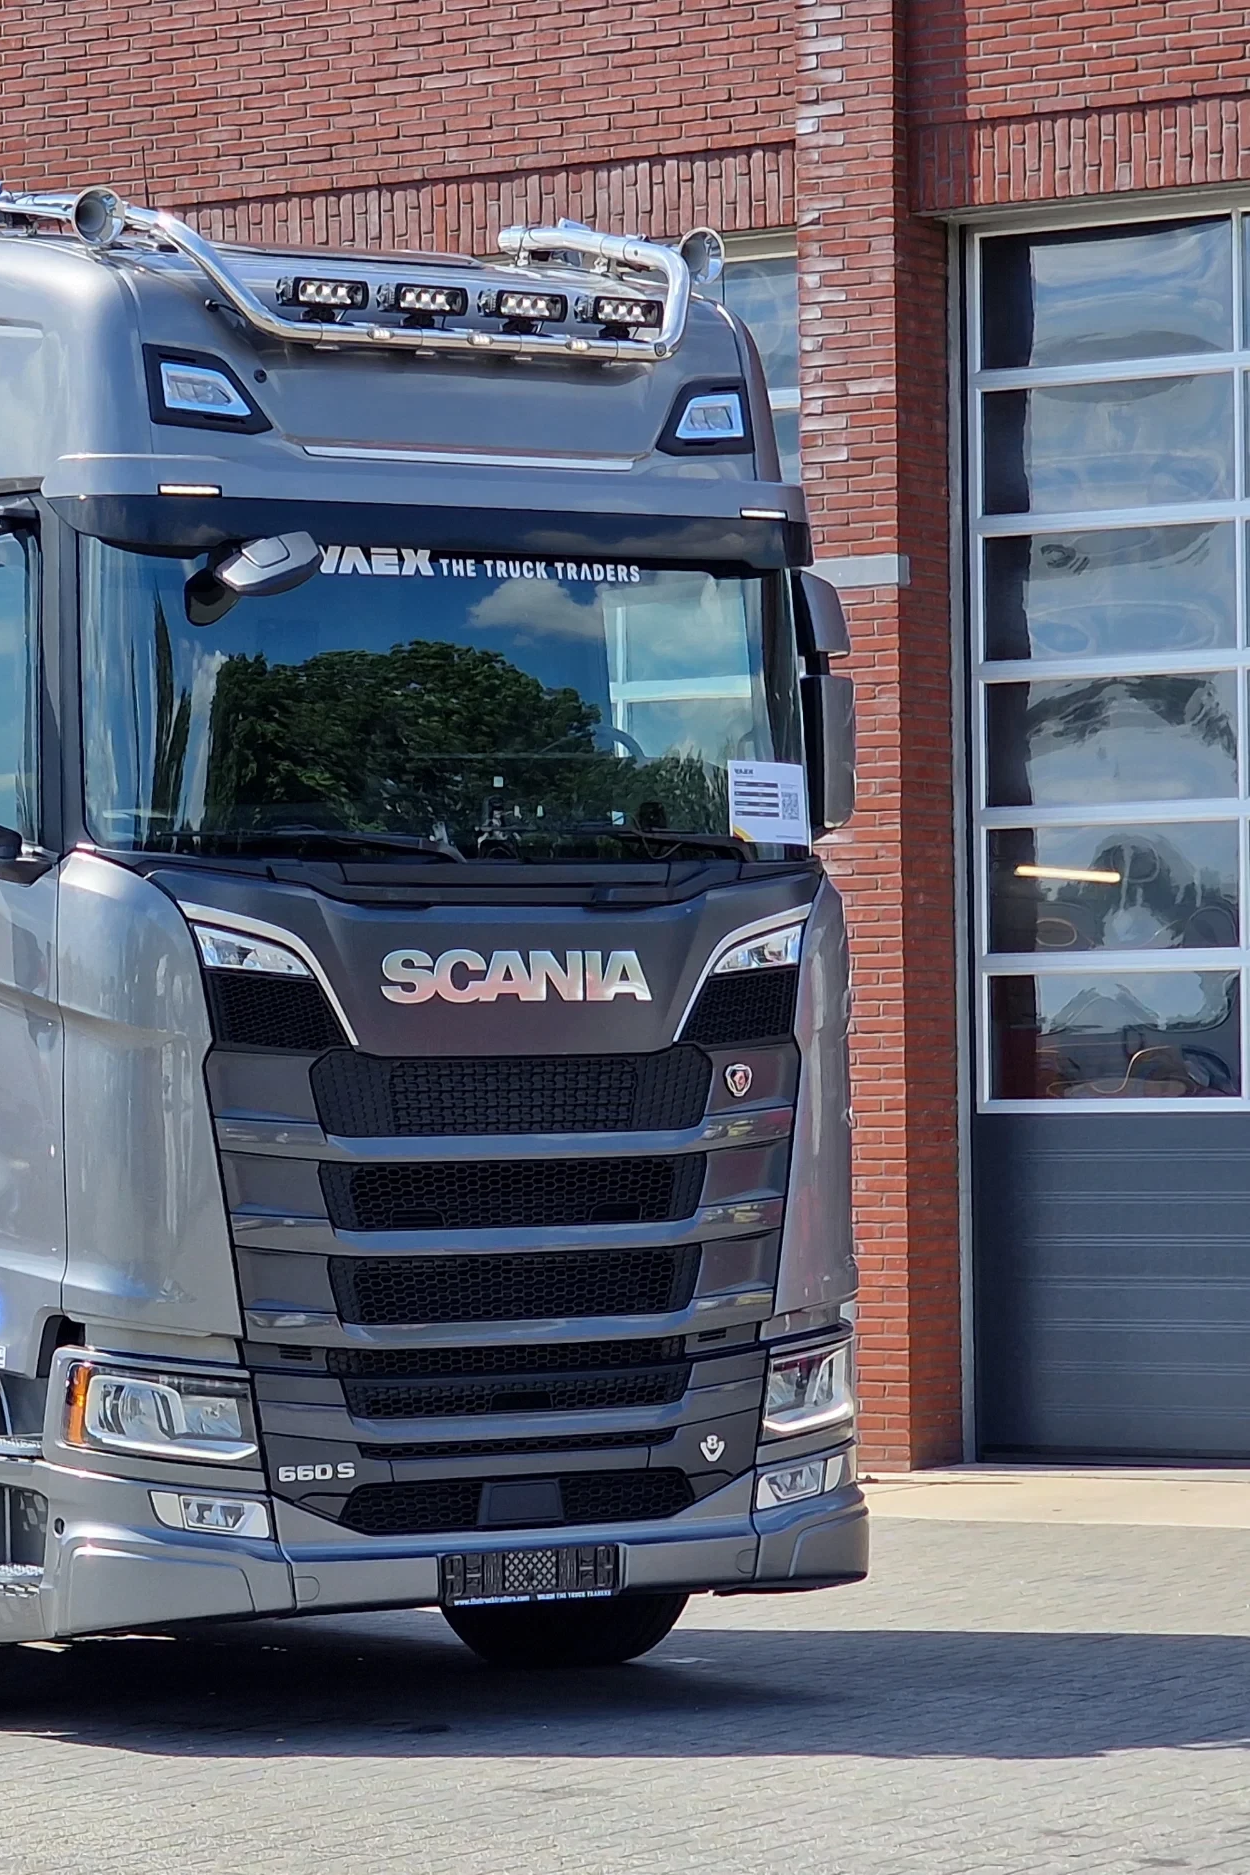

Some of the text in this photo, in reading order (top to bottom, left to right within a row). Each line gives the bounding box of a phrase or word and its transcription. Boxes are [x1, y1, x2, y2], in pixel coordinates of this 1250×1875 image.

[439, 558, 478, 578] THE
[483, 559, 548, 580] TRUCK
[554, 561, 641, 583] TRADERS
[380, 948, 652, 1004] SCANIA
[278, 1462, 356, 1482] 660 S
